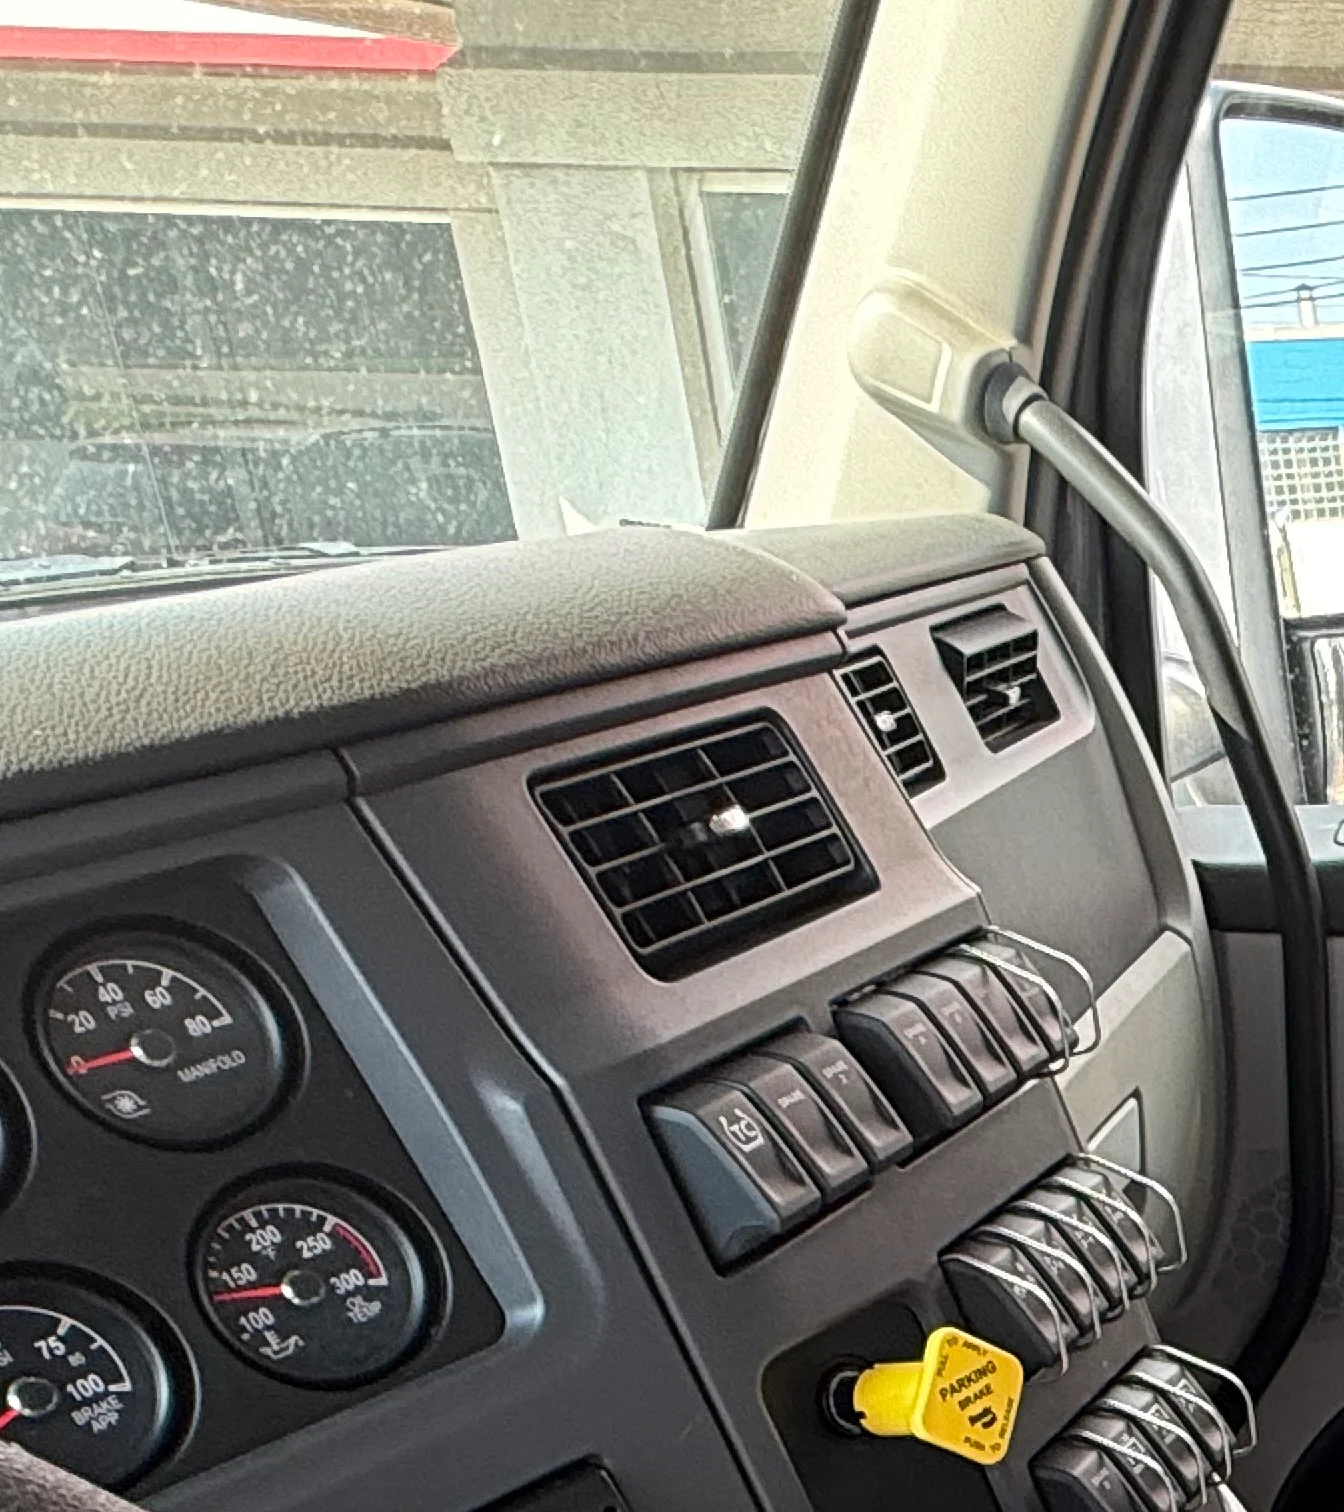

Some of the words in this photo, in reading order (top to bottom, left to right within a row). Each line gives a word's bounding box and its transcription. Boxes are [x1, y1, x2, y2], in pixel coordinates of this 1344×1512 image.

[97, 982, 124, 1004] 40
[144, 986, 172, 1010] 60
[67, 1010, 96, 1034] 20
[183, 1014, 212, 1036] 80
[176, 1050, 246, 1082] MANIFOLD
[244, 1224, 282, 1251] 200
[295, 1232, 332, 1259] 250
[221, 1262, 258, 1288] 150
[329, 1268, 366, 1295] 300
[239, 1307, 275, 1333] 100
[33, 1336, 66, 1360] 75
[66, 1373, 105, 1401] 100
[939, 1360, 997, 1403] PARKING
[70, 1394, 124, 1426] BRAKE
[957, 1382, 993, 1411] BRAKE
